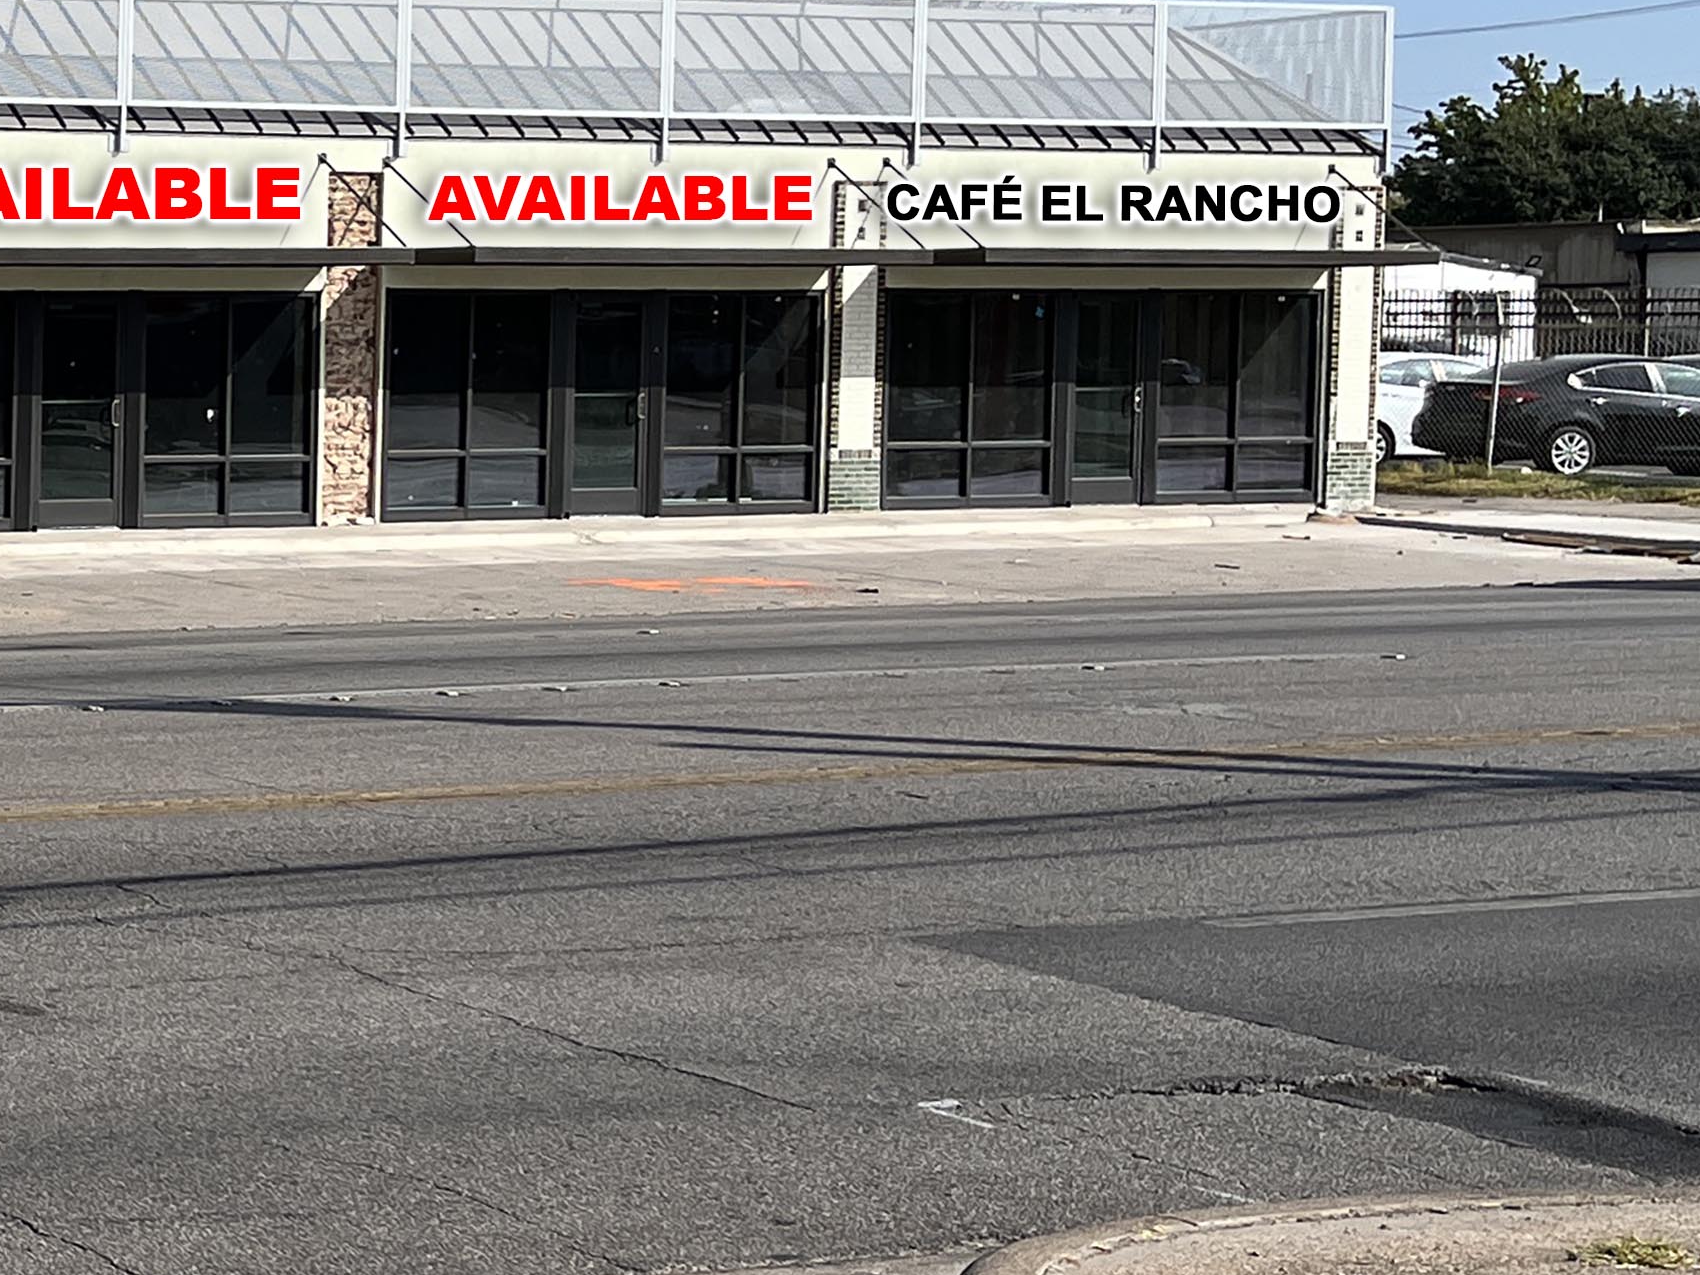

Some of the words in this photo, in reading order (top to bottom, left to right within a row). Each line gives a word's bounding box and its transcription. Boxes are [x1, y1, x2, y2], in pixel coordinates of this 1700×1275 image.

[428, 175, 813, 221] AVAILABLE
[886, 175, 1022, 221] CAFÉ
[1042, 185, 1104, 221] EL
[1121, 184, 1341, 223] RANCHO
